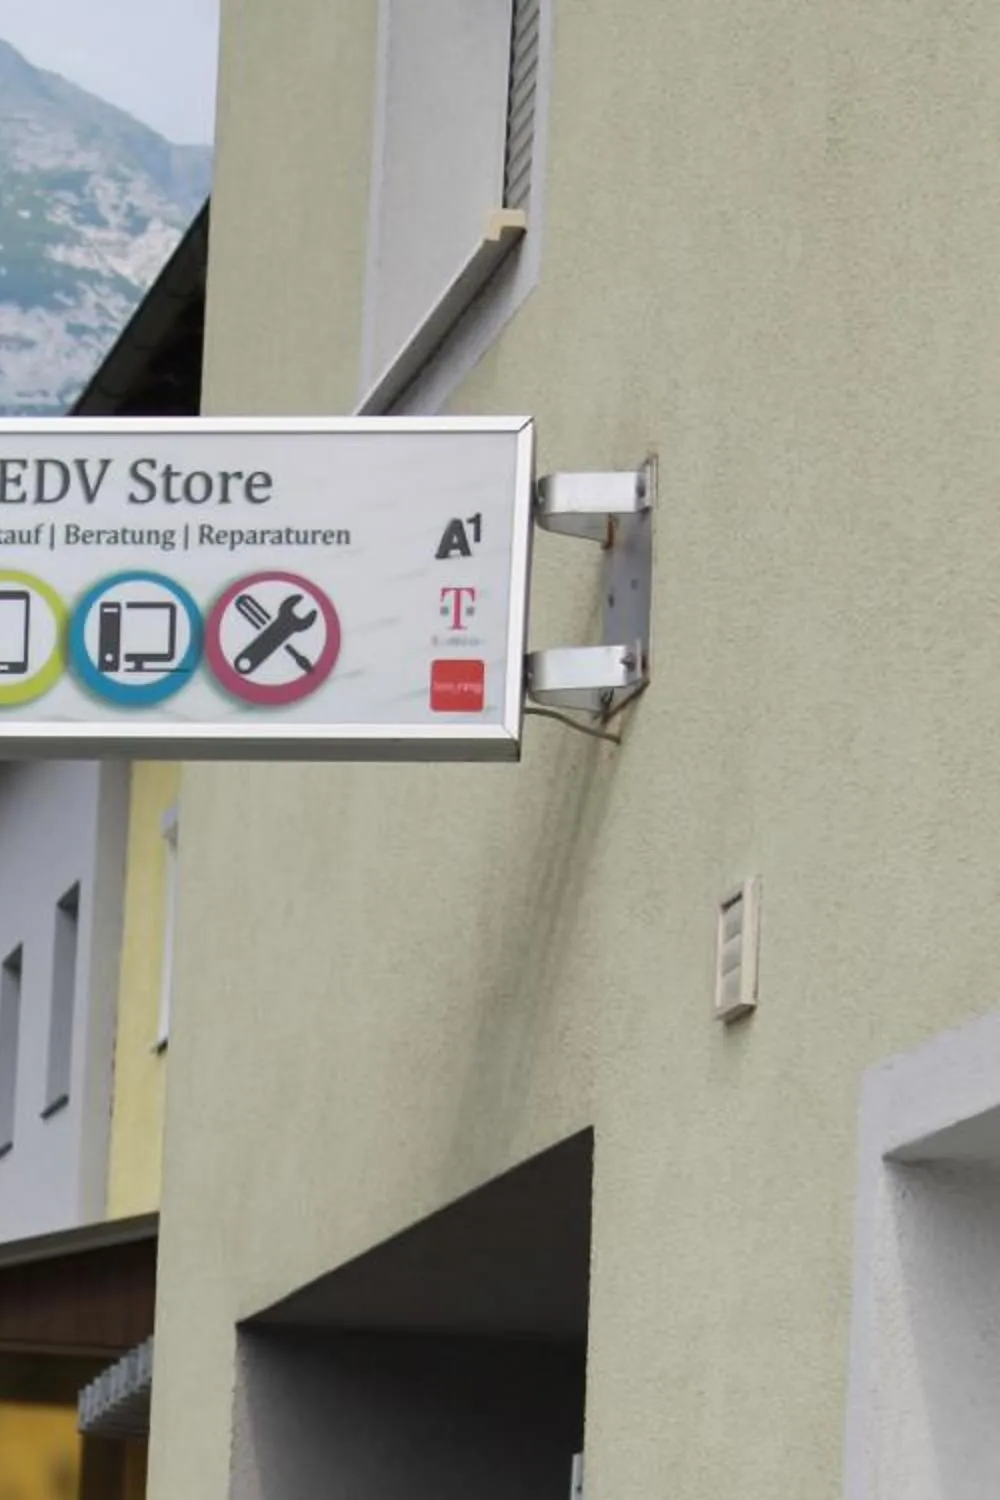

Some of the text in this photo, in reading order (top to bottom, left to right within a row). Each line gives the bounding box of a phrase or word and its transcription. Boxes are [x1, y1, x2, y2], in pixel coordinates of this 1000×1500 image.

[128, 458, 273, 505] Store
[63, 523, 176, 550] Beratung
[199, 523, 351, 551] Reparaturen
[435, 512, 482, 560] A1
